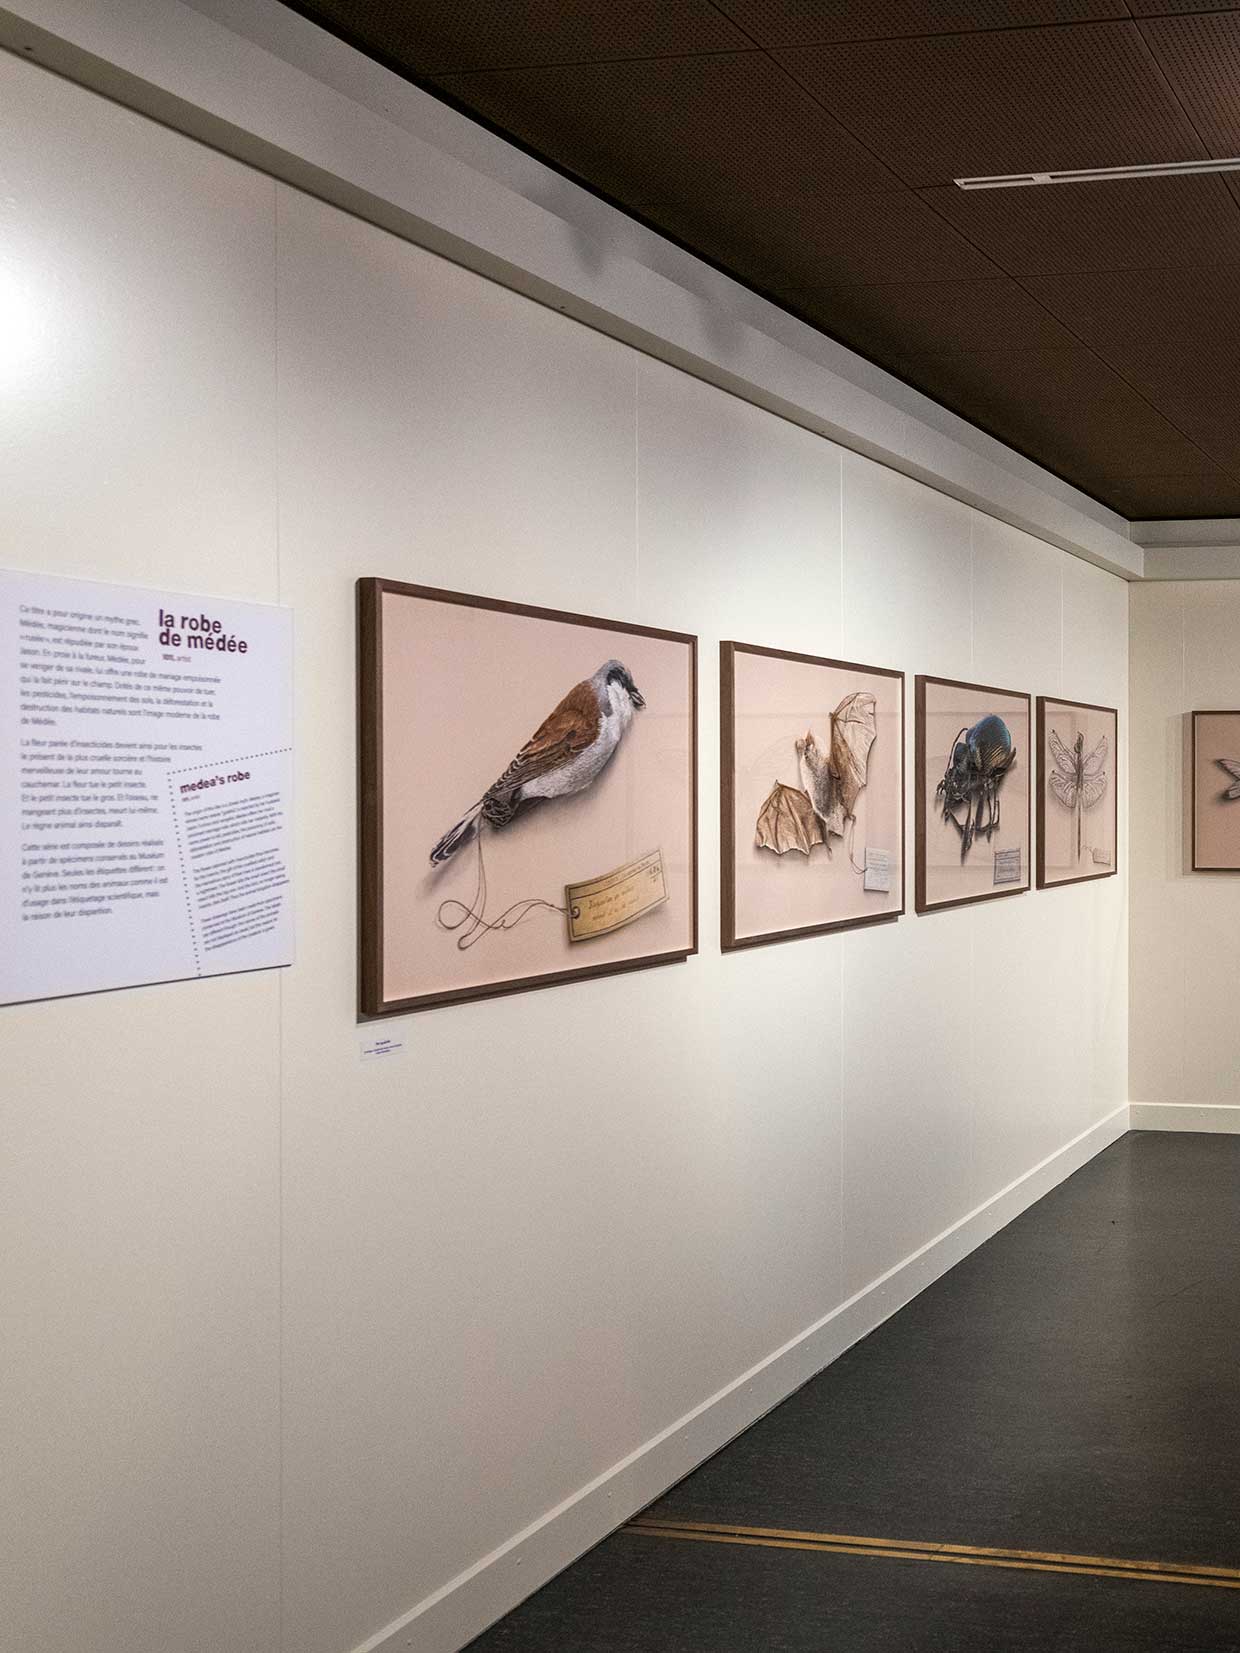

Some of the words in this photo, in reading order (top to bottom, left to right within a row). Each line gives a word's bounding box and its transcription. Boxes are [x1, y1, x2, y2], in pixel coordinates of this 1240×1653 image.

[159, 608, 174, 627] la
[181, 614, 222, 633] robe
[159, 628, 181, 646] de
[188, 632, 247, 653] médée
[180, 776, 226, 793] medea's
[227, 771, 250, 783] robe
